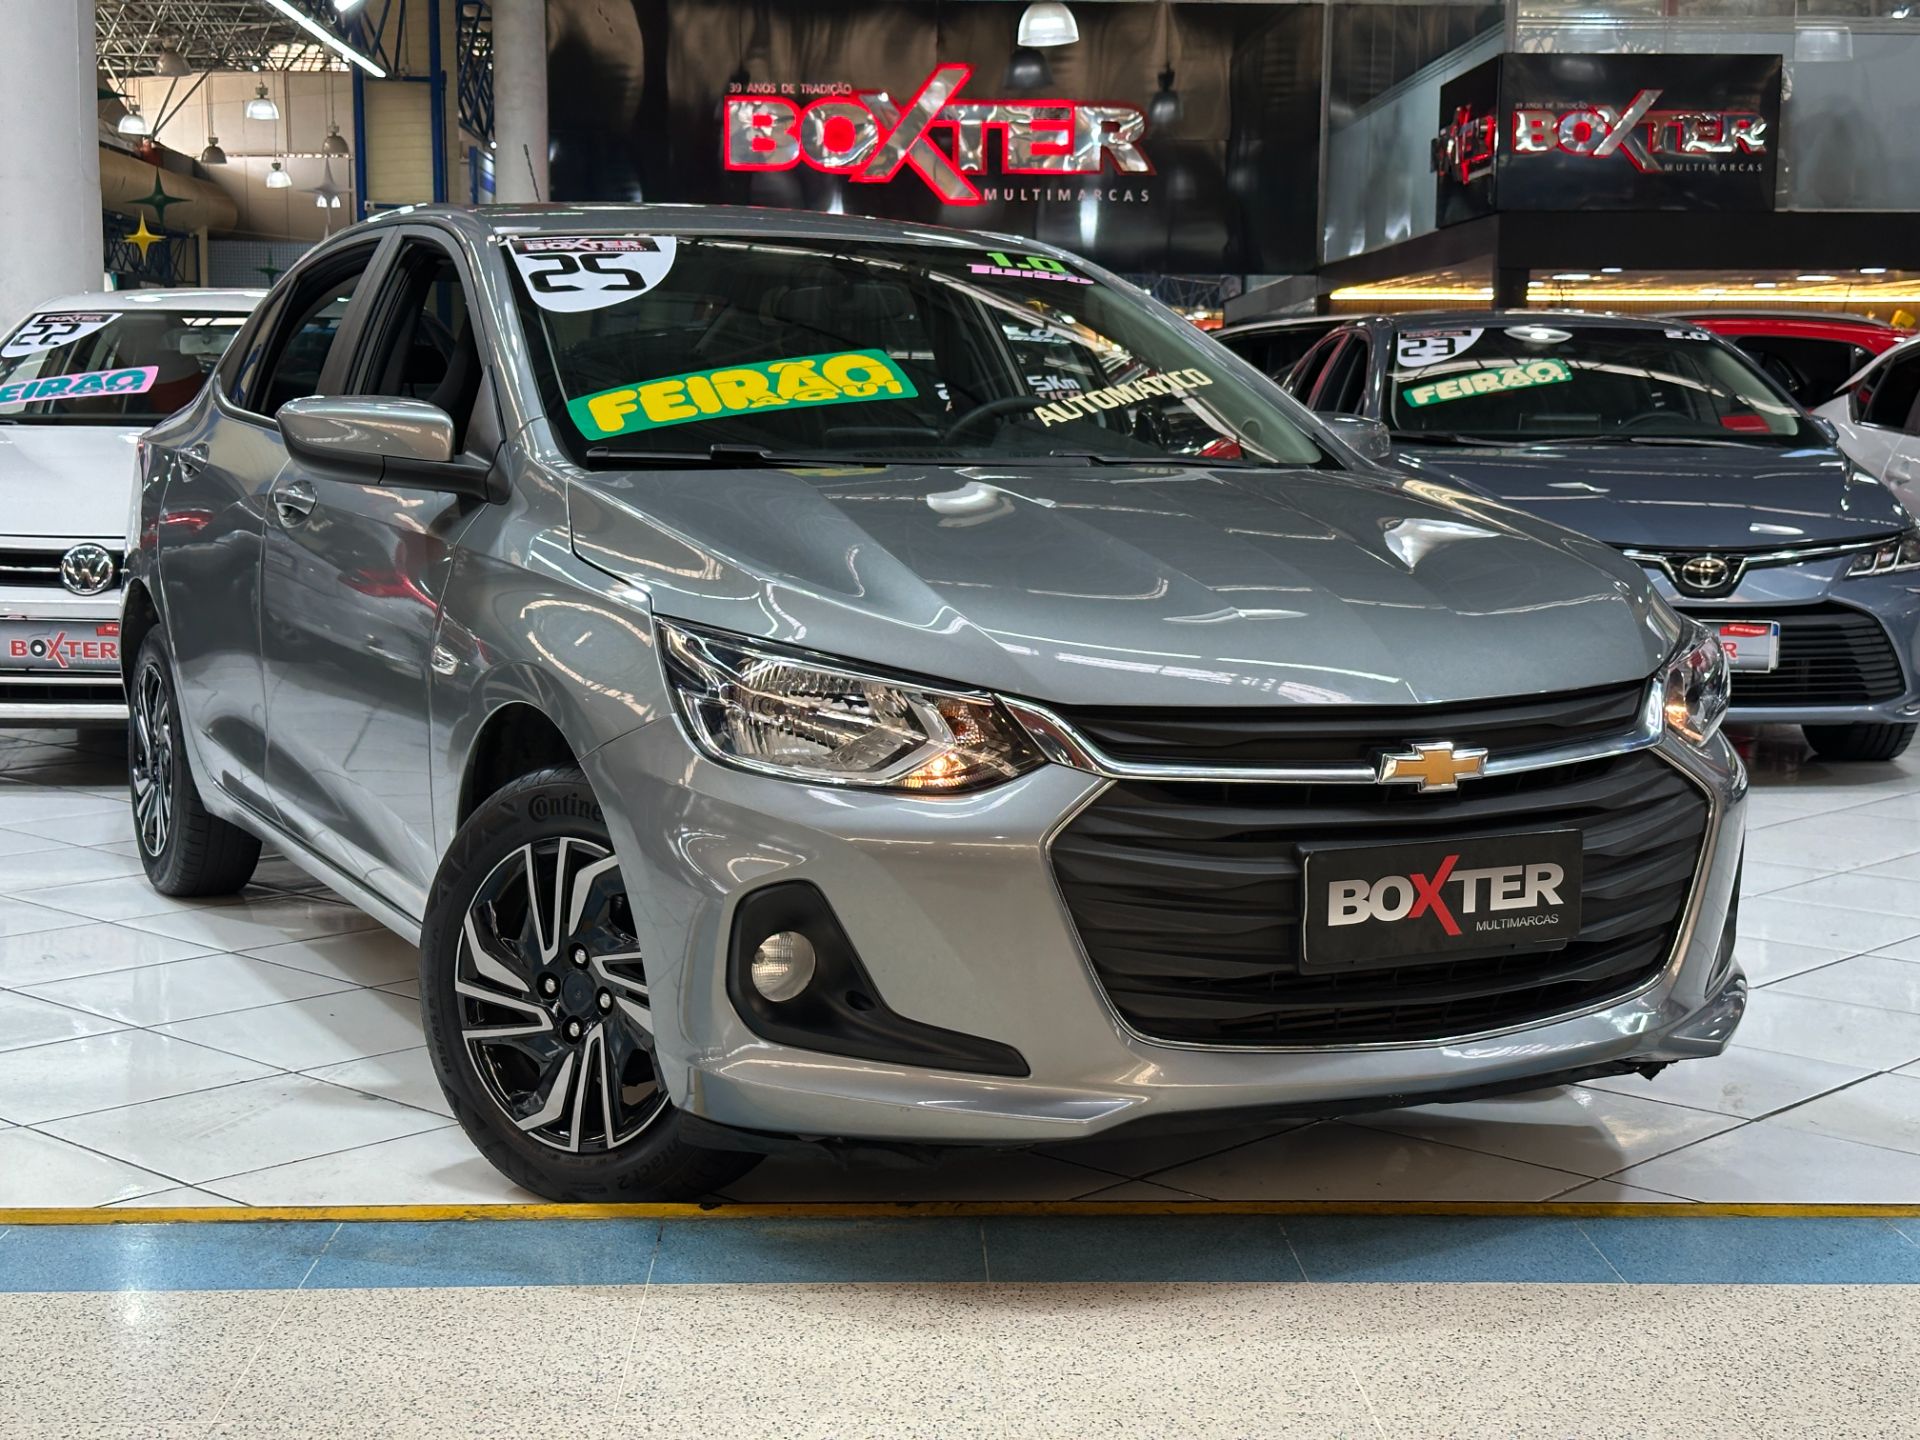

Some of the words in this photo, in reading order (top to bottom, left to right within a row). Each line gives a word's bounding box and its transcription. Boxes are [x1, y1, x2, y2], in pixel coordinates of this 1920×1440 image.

[729, 83, 742, 93] 39
[746, 83, 776, 94] ANOS
[781, 83, 796, 94] DE
[801, 81, 853, 96] TRADIÇÃO
[724, 62, 1157, 206] BOXTER
[1513, 89, 1766, 174] BOXTER
[1664, 163, 1762, 172] MULTIMARCAS
[984, 187, 1150, 202] MULTIMARCAS
[523, 238, 641, 251] BOXTER
[525, 253, 647, 292] 25
[986, 252, 1066, 273] 1.0
[1401, 337, 1456, 357] 23
[588, 354, 895, 432] FEIRÃO
[1412, 361, 1564, 405] FEIRÃO
[10, 632, 119, 667] BOXTER
[1328, 854, 1564, 935] BOXTER
[1476, 914, 1559, 932] MULTIMARCAS
